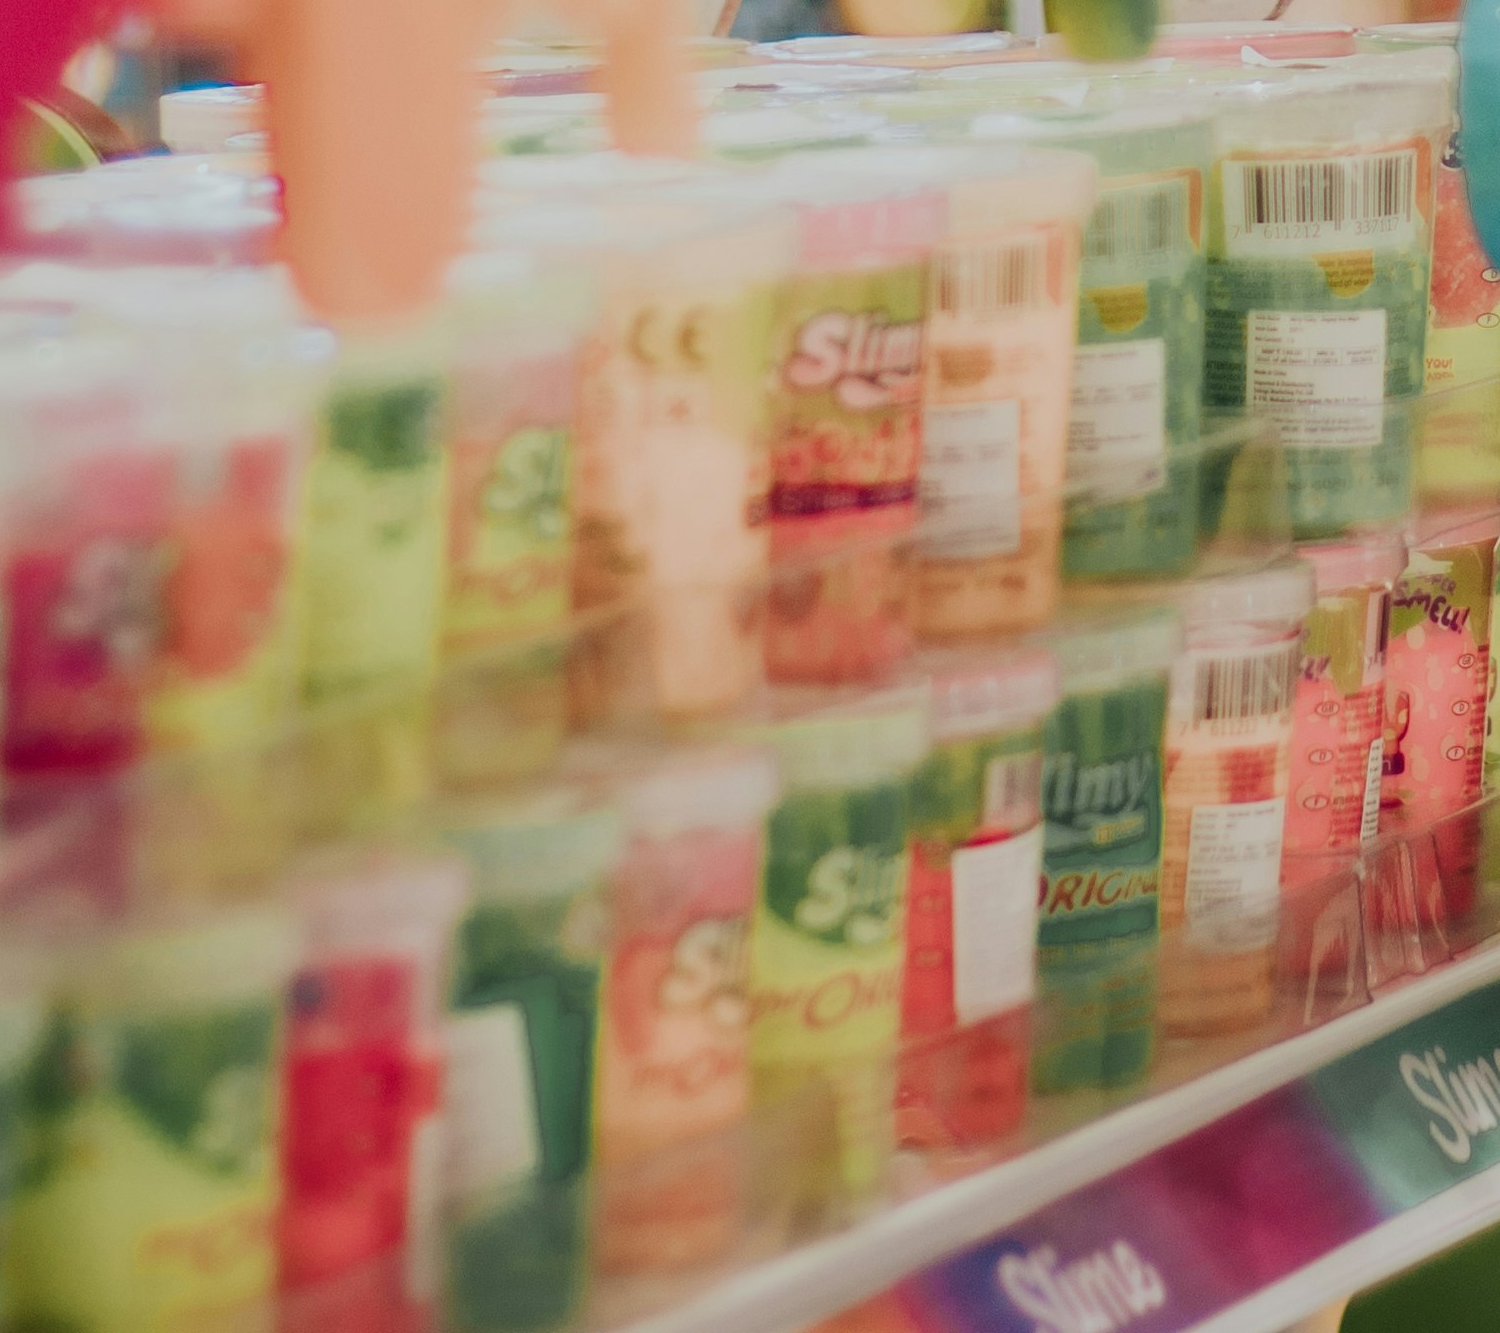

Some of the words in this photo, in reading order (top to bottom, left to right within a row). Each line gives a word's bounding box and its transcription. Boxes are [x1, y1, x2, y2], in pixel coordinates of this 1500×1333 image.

[1263, 223, 1322, 240] 611212
[1355, 216, 1400, 236] 337117
[781, 307, 921, 393] Slim
[1425, 357, 1458, 370] YOU!
[999, 1238, 1167, 1333] Slime
